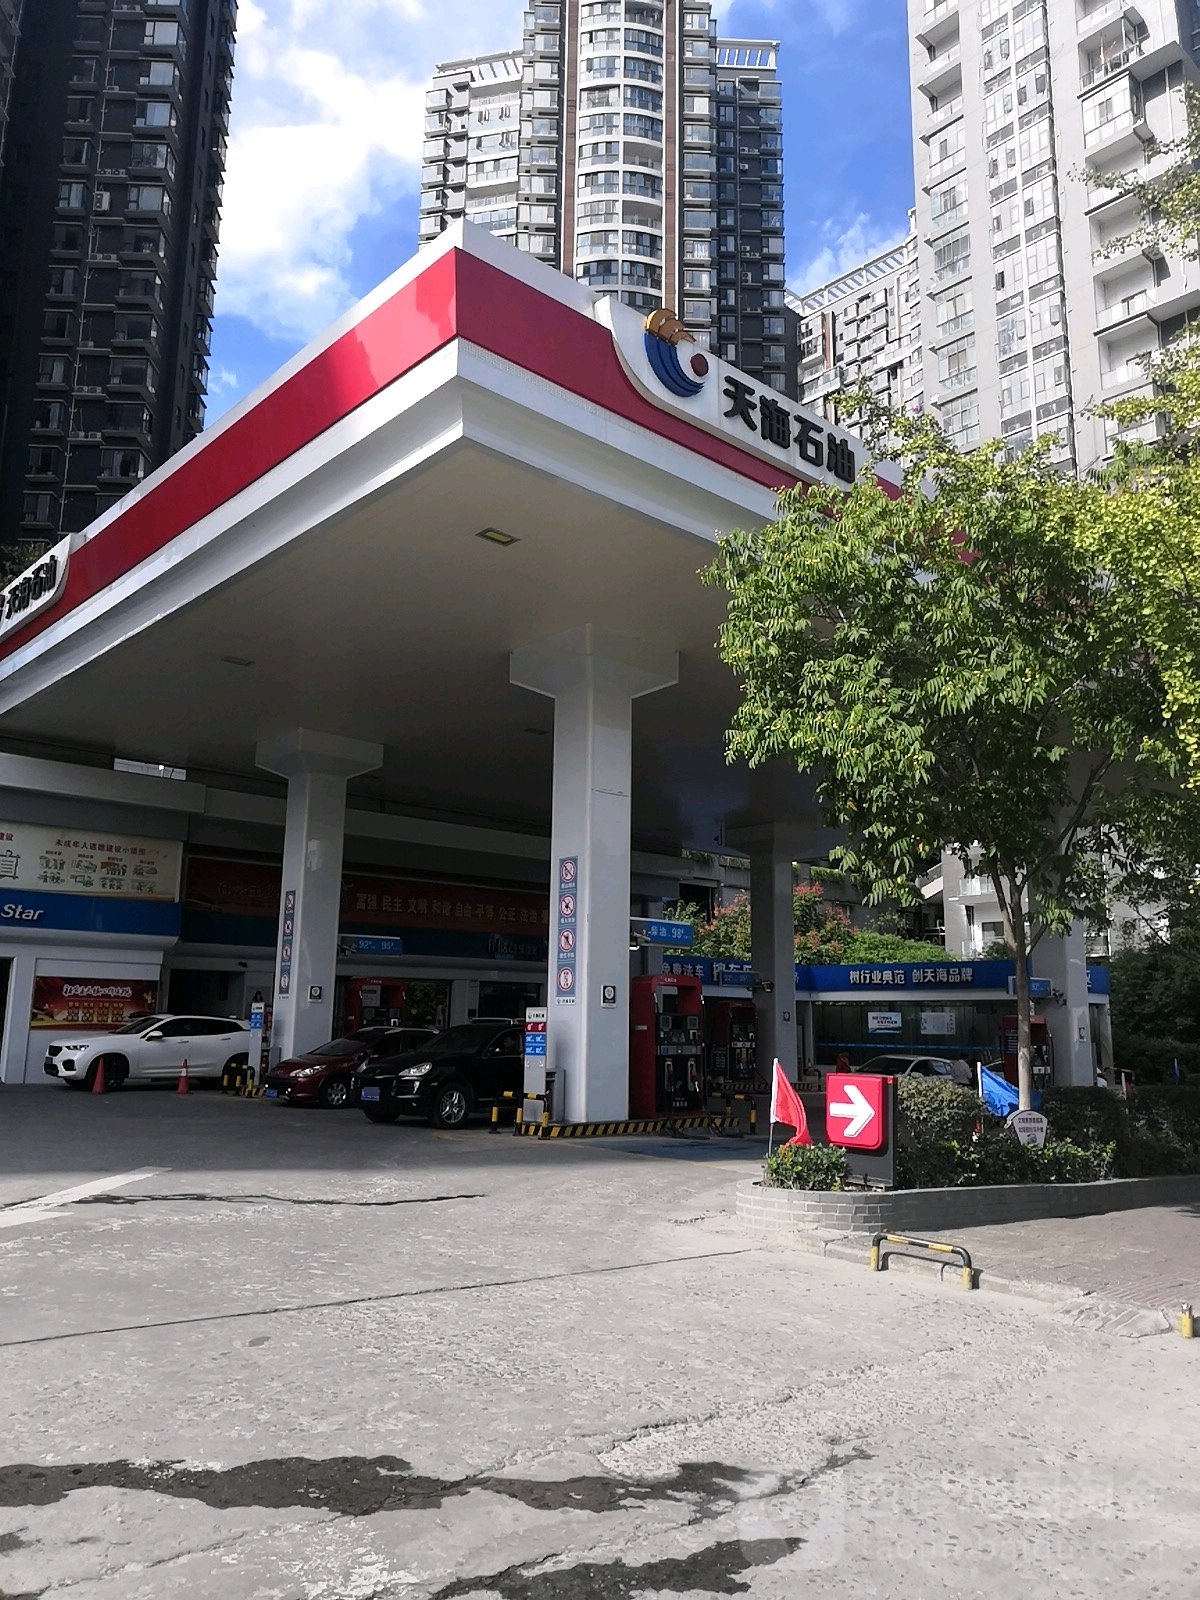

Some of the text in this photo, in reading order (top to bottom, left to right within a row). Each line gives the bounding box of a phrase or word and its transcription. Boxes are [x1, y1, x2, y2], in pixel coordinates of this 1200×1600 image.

[722, 374, 857, 485] 天海石油
[1, 904, 44, 921] Star
[355, 892, 378, 911] 富强
[382, 895, 403, 913] 民主
[407, 898, 428, 915] 文明
[431, 900, 454, 918] 和谐
[455, 903, 472, 919] 自由
[475, 904, 495, 921] 平等
[498, 906, 516, 922] 公正
[520, 907, 538, 923] 法治
[849, 967, 973, 985] 树行业典范 创天海品牌
